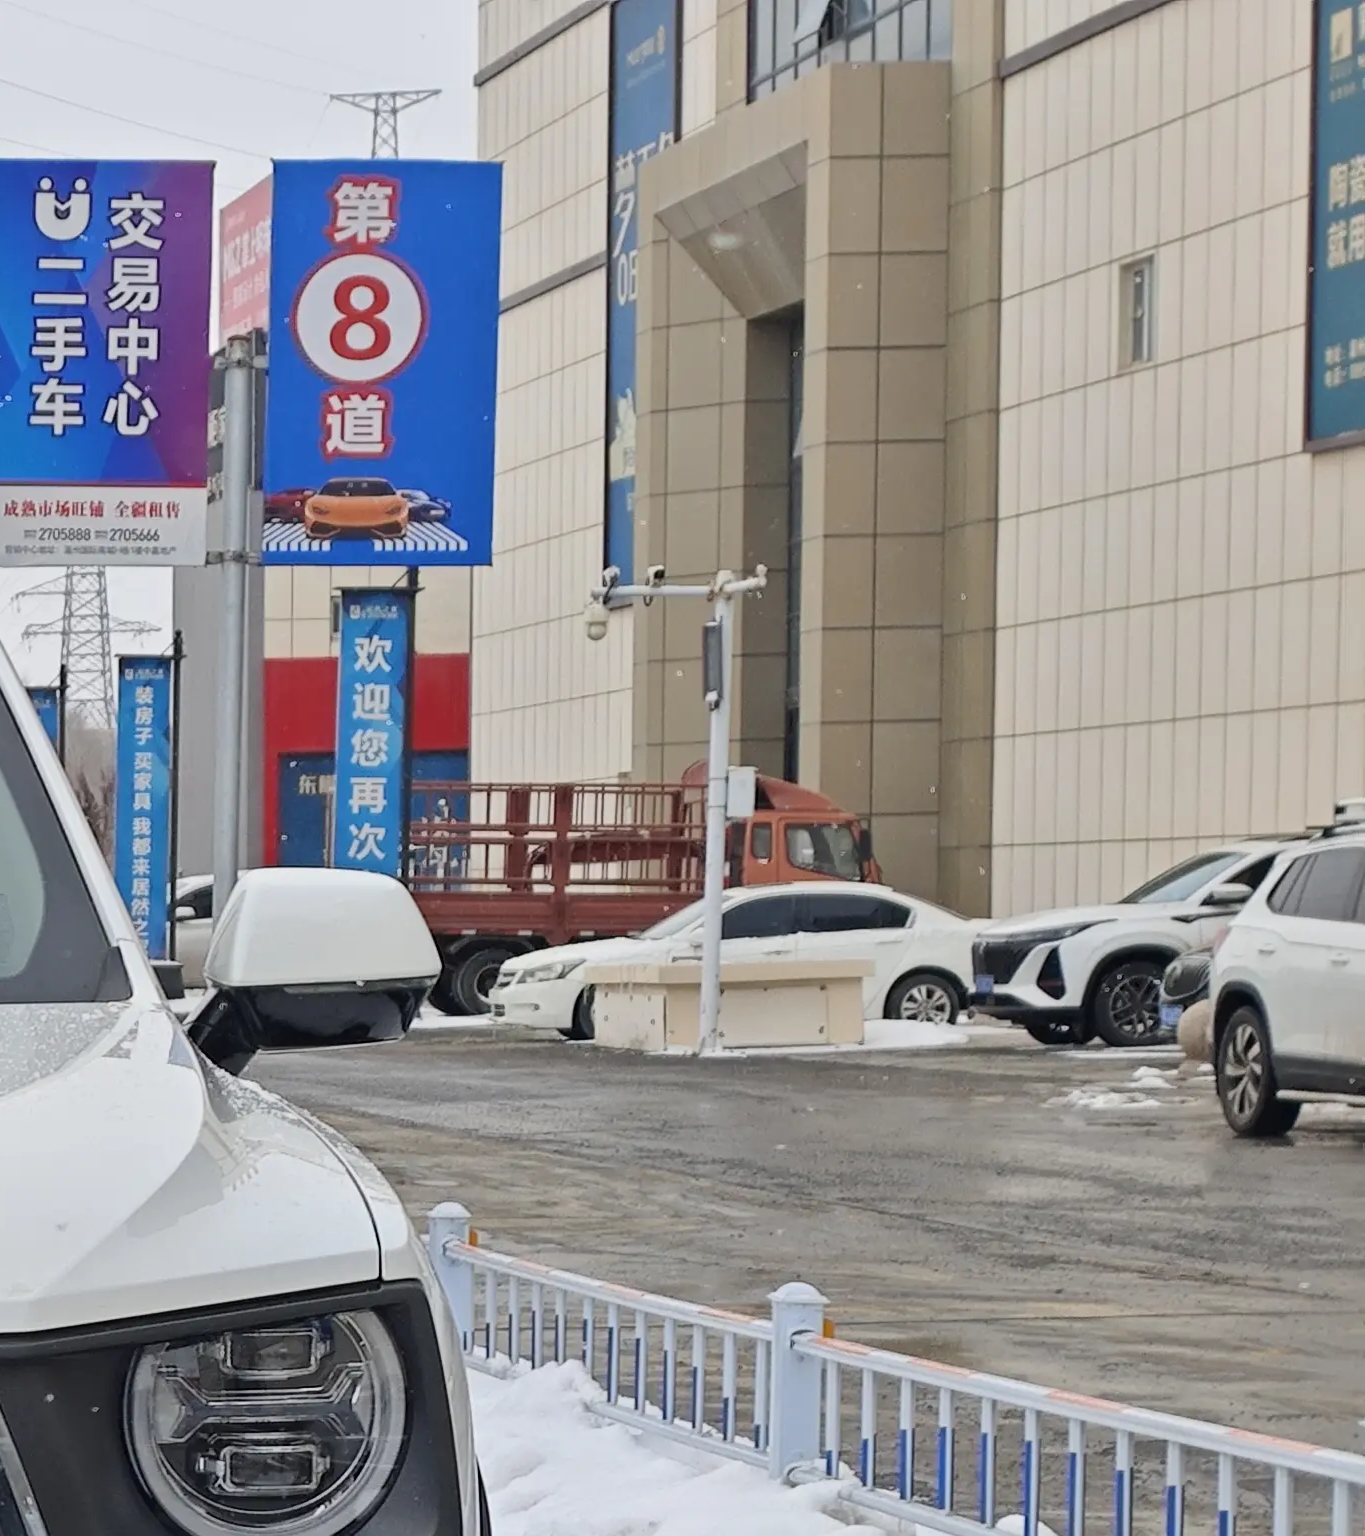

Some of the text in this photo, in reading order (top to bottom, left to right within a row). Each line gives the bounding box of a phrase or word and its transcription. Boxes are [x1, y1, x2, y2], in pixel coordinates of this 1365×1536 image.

[29, 257, 87, 436] 二手车
[102, 192, 165, 437] 交易中心
[3, 500, 181, 519] 成熟市场旺铺 全疆租售
[38, 527, 92, 542] 2705888
[109, 528, 161, 542] 2705666
[134, 685, 154, 745] 装房子
[347, 634, 393, 861] 欢迎您再次
[132, 751, 153, 811] 买家具
[130, 817, 153, 956] 我都来居然之
